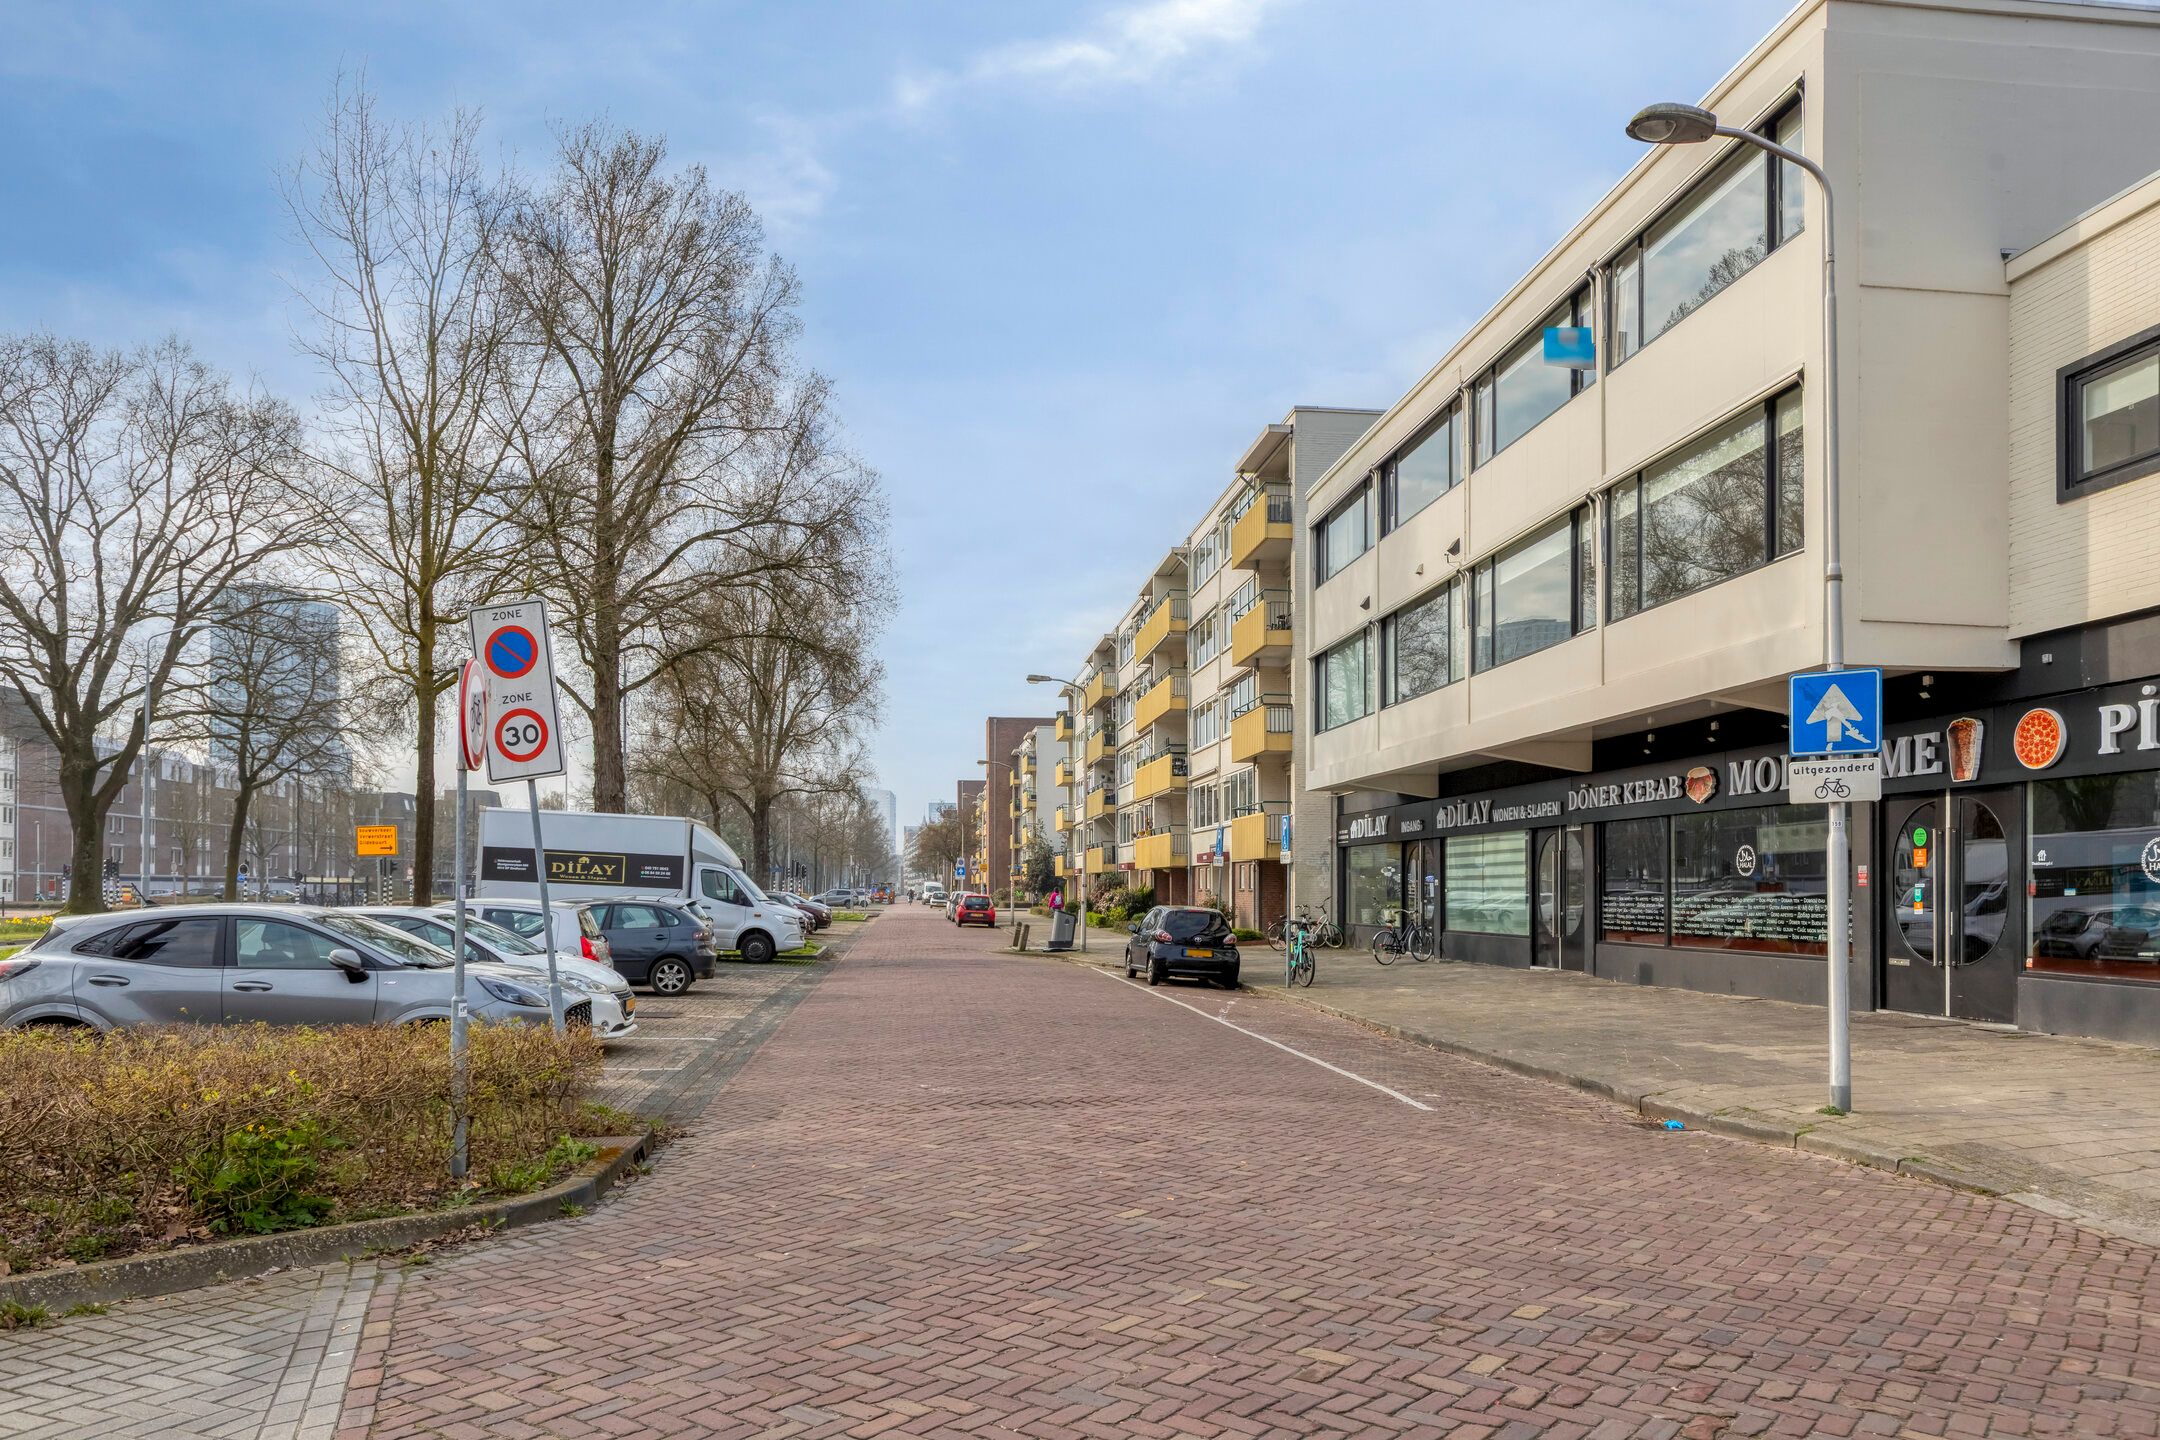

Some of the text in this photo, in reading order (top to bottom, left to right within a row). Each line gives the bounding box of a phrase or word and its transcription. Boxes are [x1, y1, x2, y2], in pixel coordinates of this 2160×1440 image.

[492, 609, 522, 621] ZONE
[502, 692, 532, 705] ZONE
[505, 723, 539, 747] 30
[1794, 762, 1875, 777] uitgezonderd
[1568, 775, 1681, 811] DÖNER KEBAB
[1493, 806, 1519, 823] WONEN
[1520, 805, 1527, 819] &
[1527, 801, 1562, 819] SLAPEN
